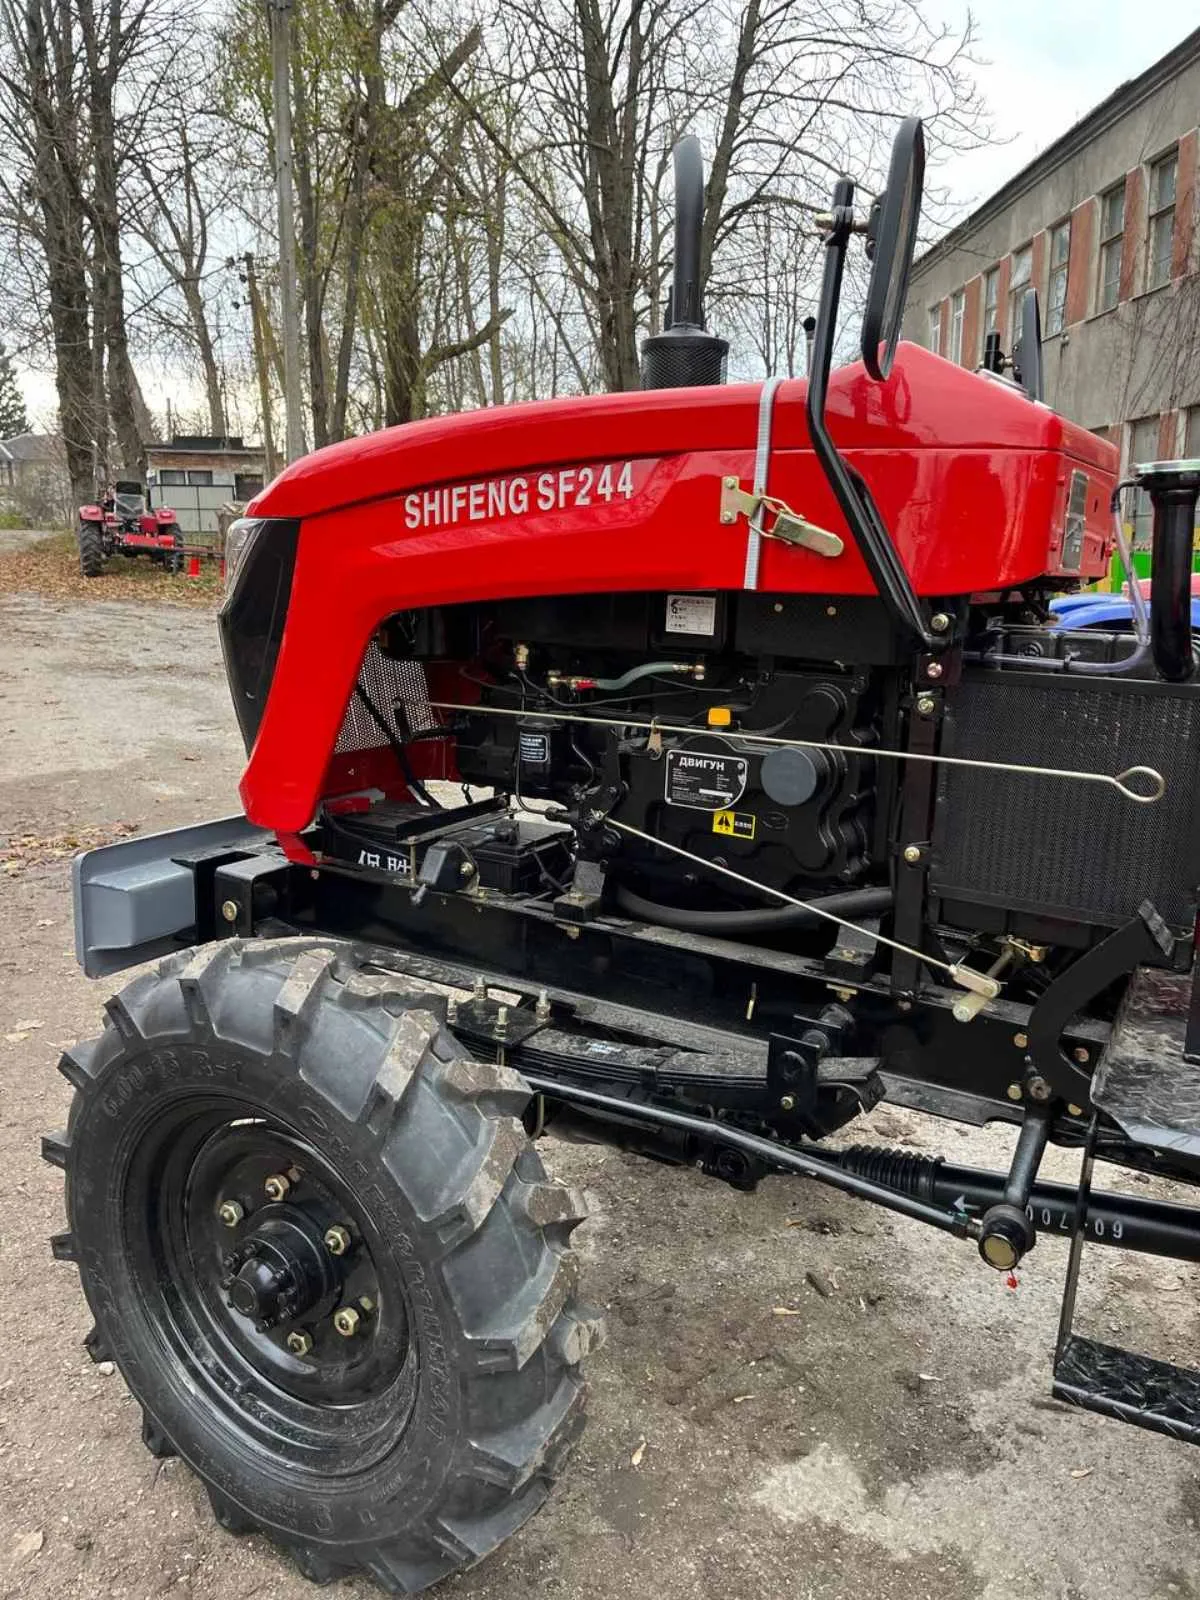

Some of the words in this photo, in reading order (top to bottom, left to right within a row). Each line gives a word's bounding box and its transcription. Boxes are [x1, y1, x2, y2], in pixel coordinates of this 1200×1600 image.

[404, 476, 529, 529] SHIFENG
[537, 461, 634, 511] SF244
[679, 757, 725, 771] ДВИГУН
